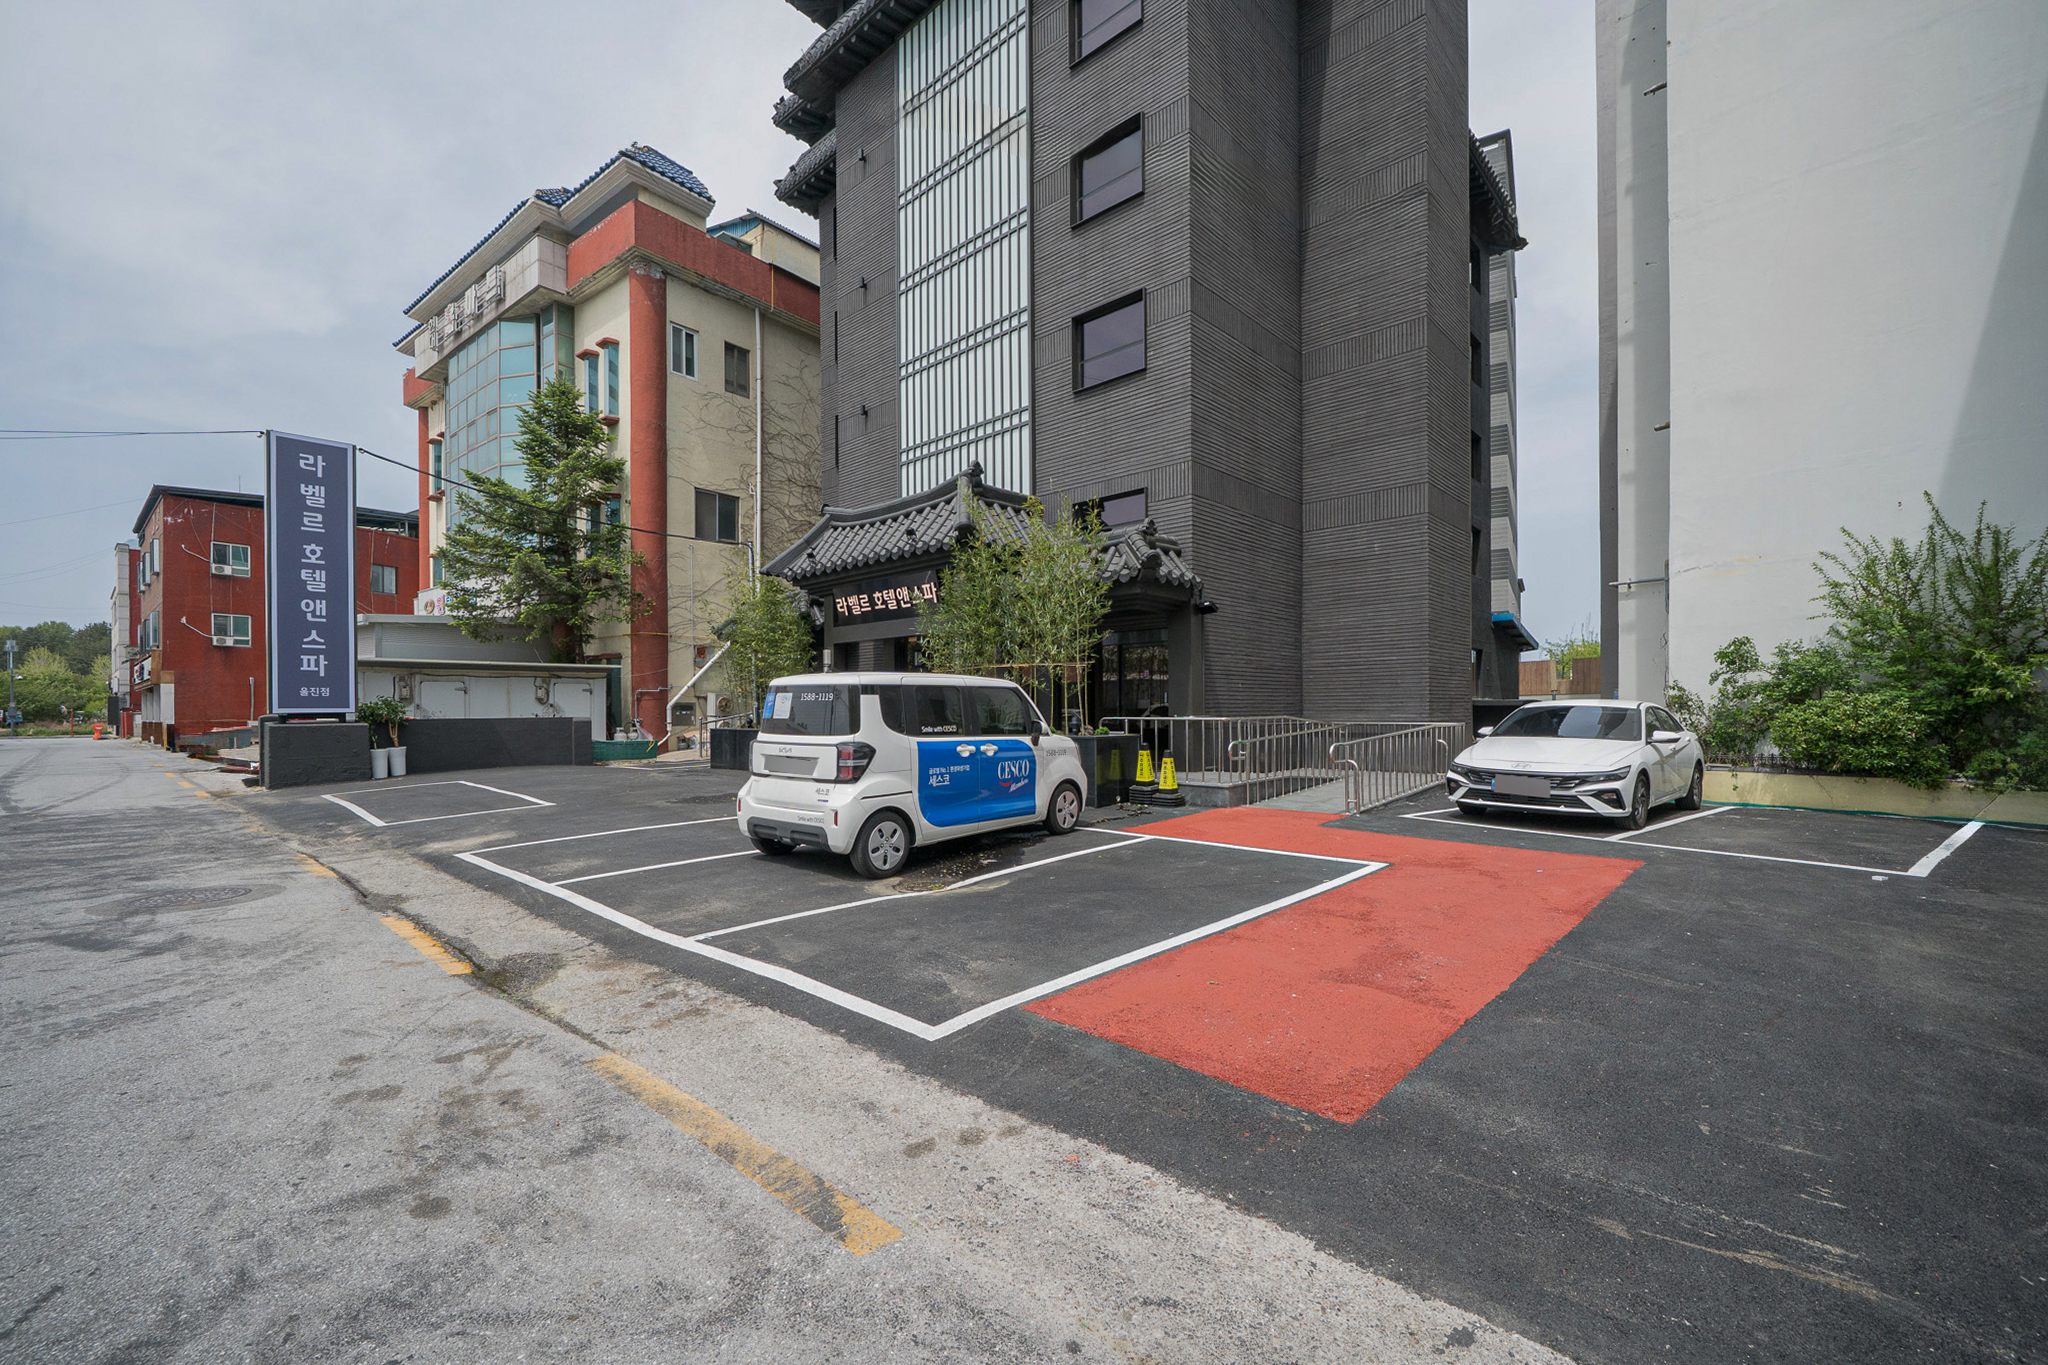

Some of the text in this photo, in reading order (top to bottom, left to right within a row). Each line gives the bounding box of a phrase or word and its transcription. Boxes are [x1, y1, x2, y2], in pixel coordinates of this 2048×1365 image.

[299, 453, 328, 677] 라벨르 호텔앤스파
[835, 582, 937, 616] 라벨르 호텔앤스파
[800, 692, 834, 701] 1588-1119
[997, 759, 1030, 780] CESCO
[928, 774, 951, 787] 세스코
